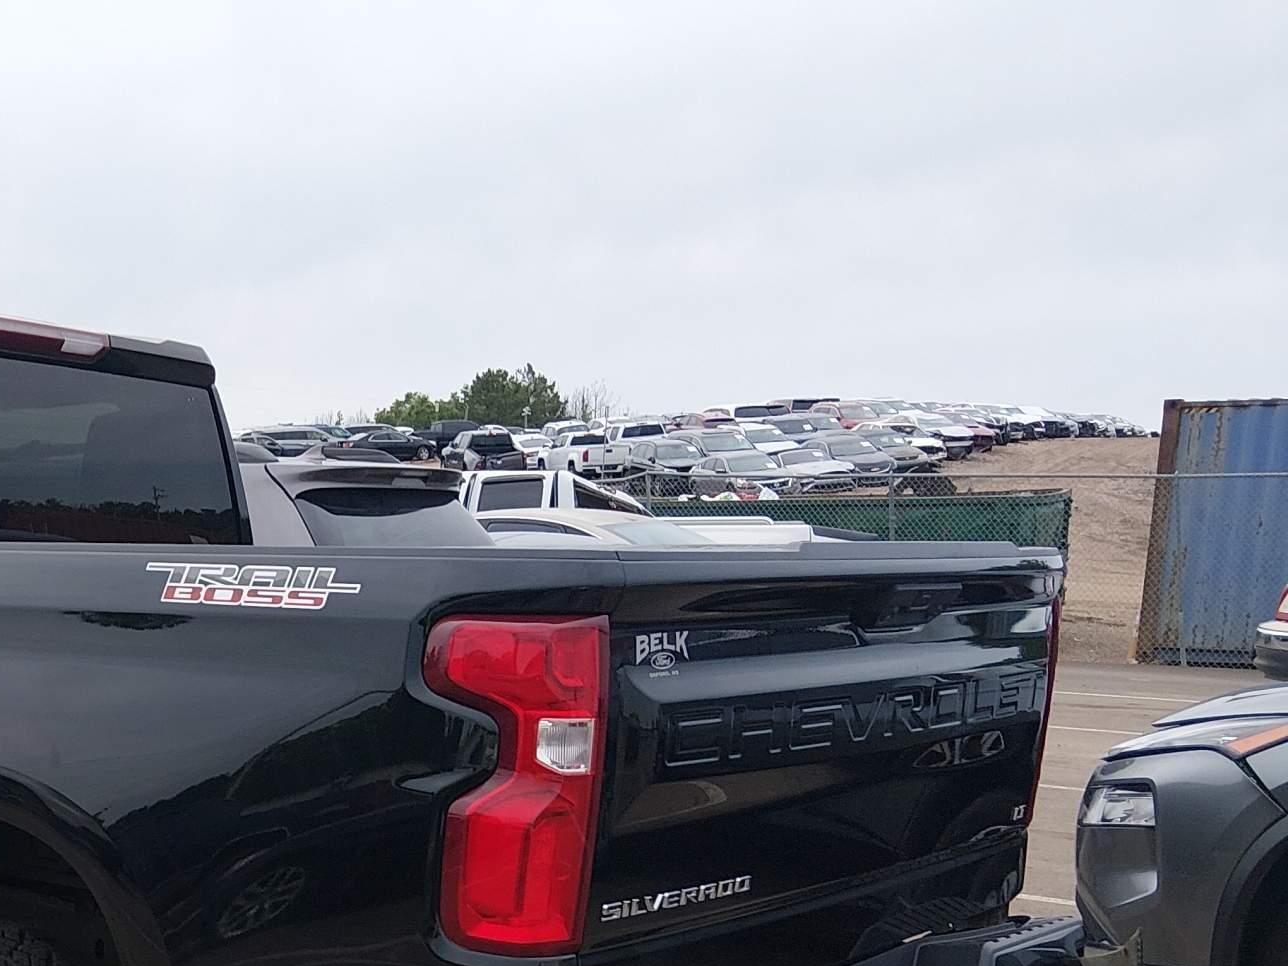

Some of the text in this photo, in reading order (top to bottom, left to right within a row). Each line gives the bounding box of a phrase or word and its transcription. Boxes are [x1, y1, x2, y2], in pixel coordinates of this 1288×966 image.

[146, 562, 361, 594] TRAIL
[161, 583, 327, 610] BOSS
[635, 630, 690, 666] BELK
[665, 670, 1046, 767] CHEVROLET
[1013, 804, 1027, 821] LT
[600, 875, 753, 922] SILVERADO
